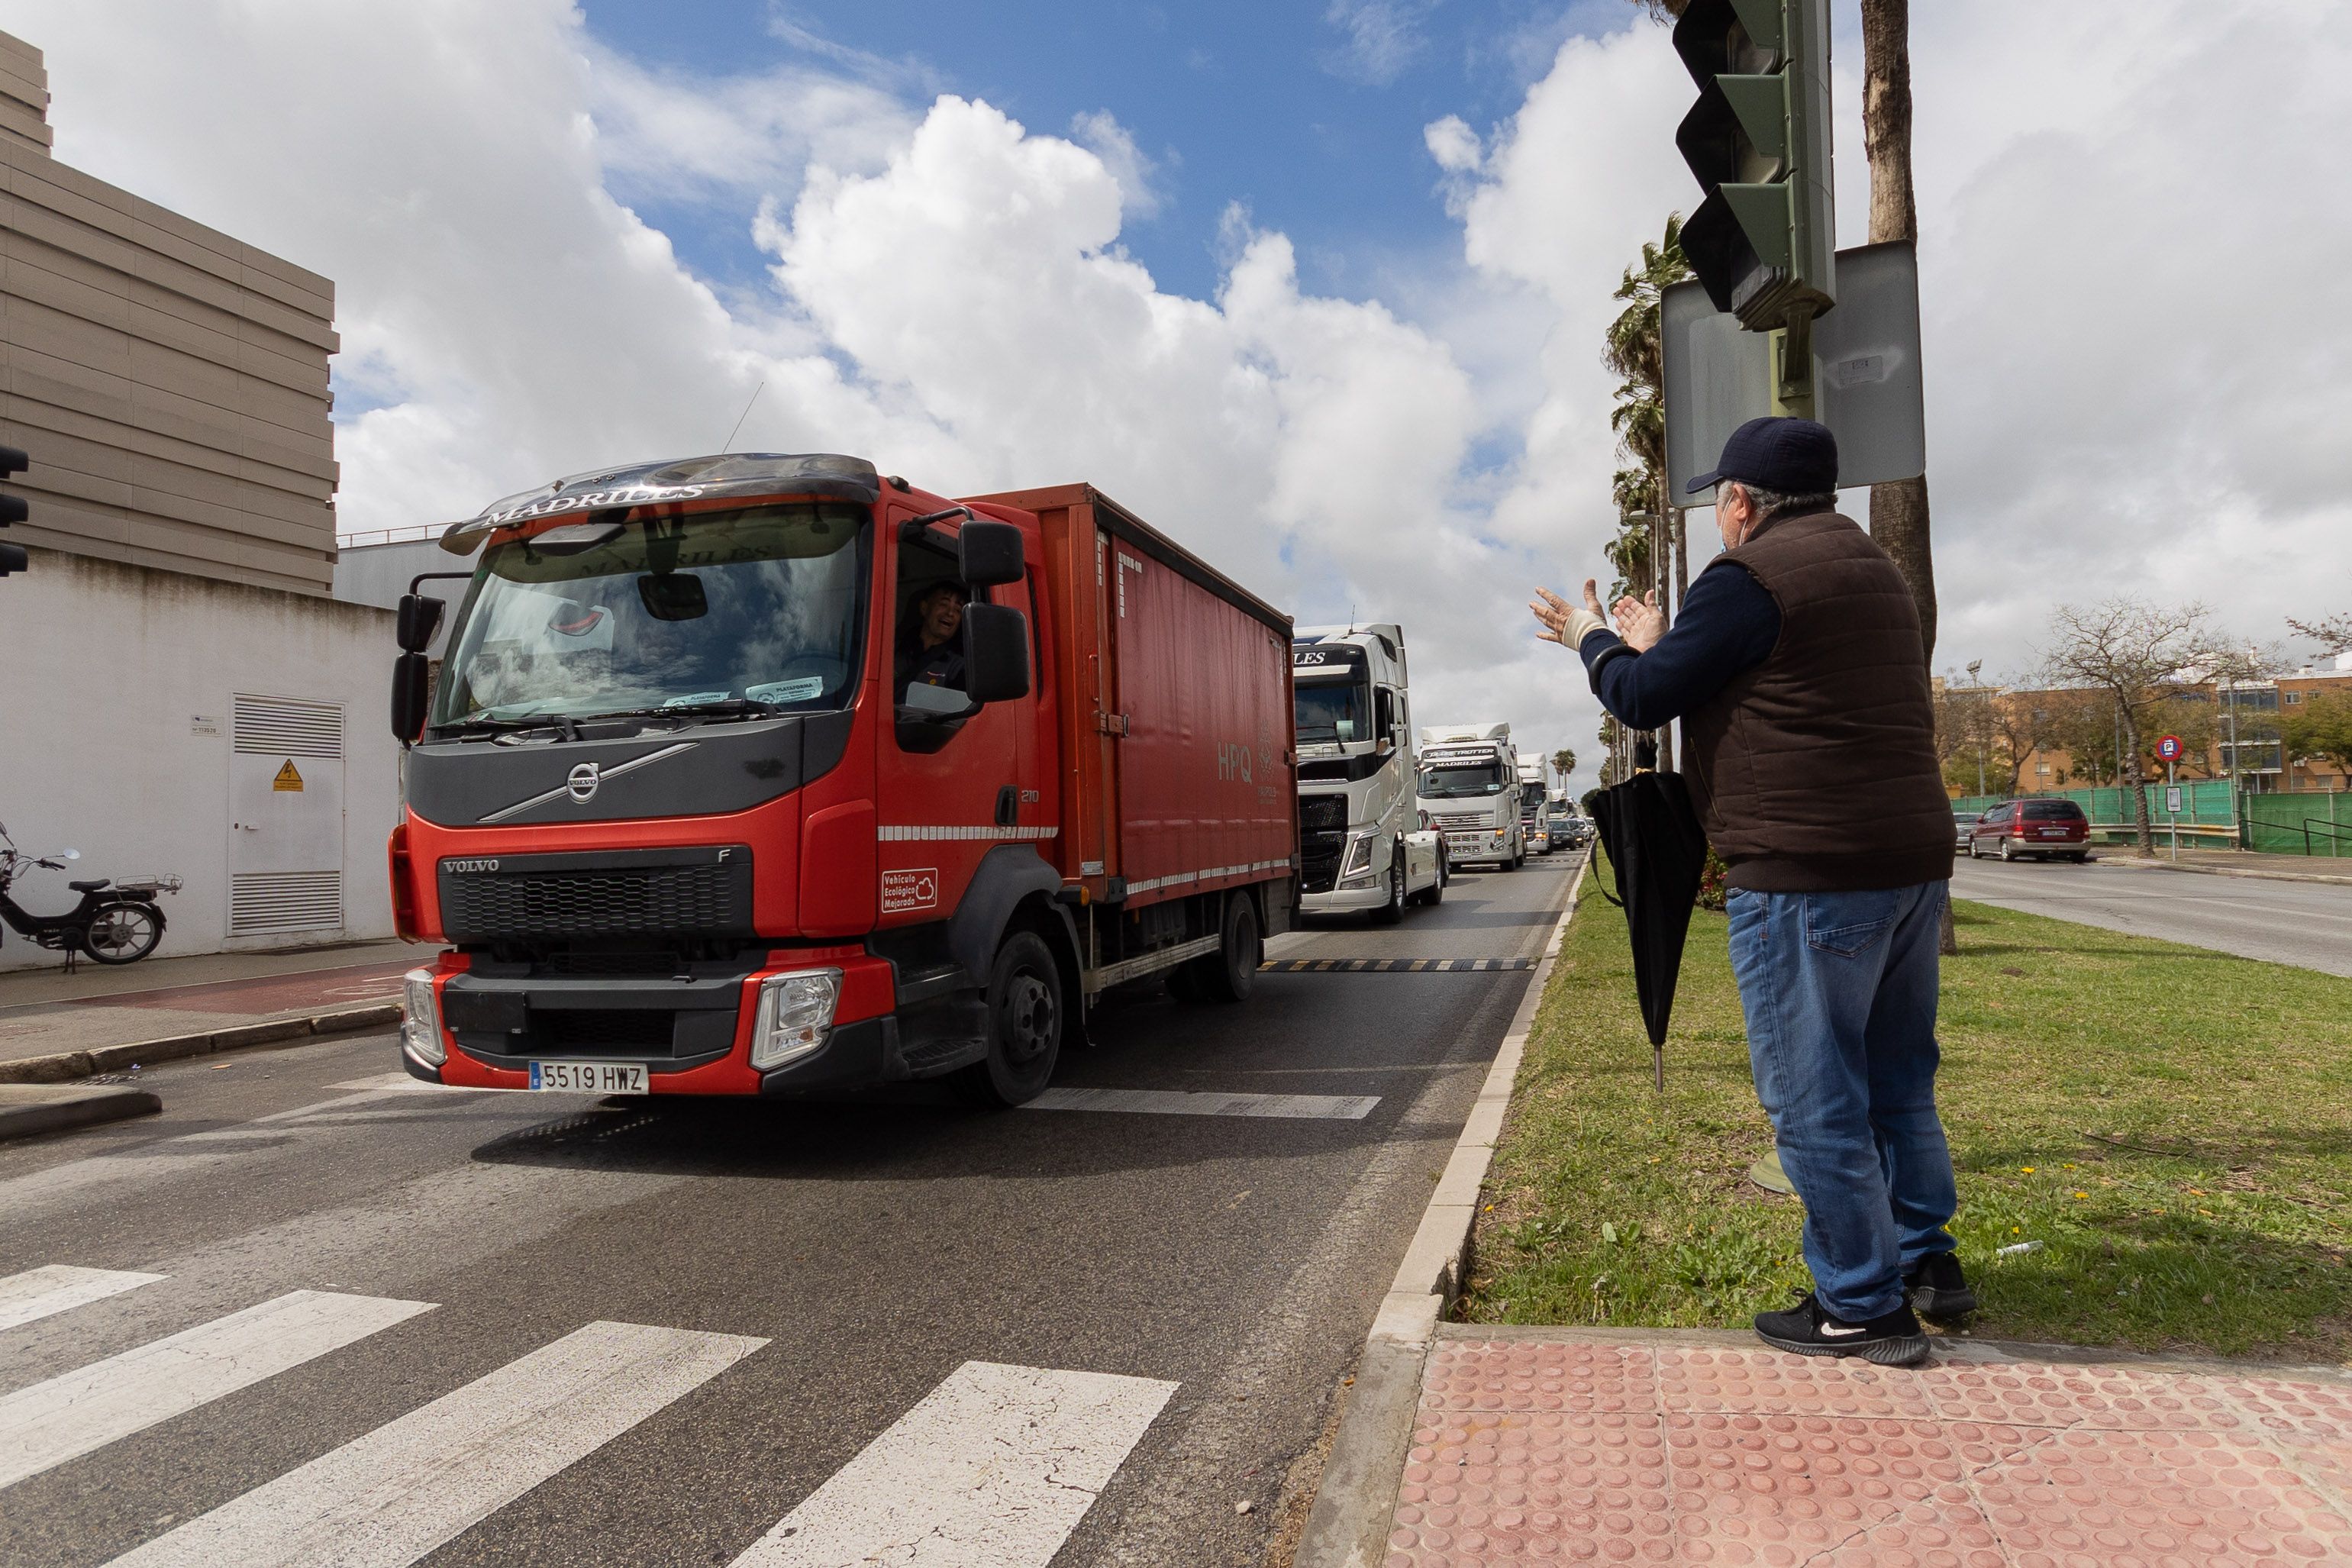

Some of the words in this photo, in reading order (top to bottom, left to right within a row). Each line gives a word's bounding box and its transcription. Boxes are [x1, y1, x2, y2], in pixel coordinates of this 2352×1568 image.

[482, 483, 706, 527] MADRILES
[1021, 789, 1039, 802] 210
[718, 849, 731, 863] F
[444, 860, 500, 873] VOLVO
[885, 873, 916, 885] Vehículo
[885, 886, 915, 897] Ecológico
[885, 897, 915, 908] Mejorado
[544, 1065, 595, 1089] 5519
[603, 1066, 642, 1090] HWZ
